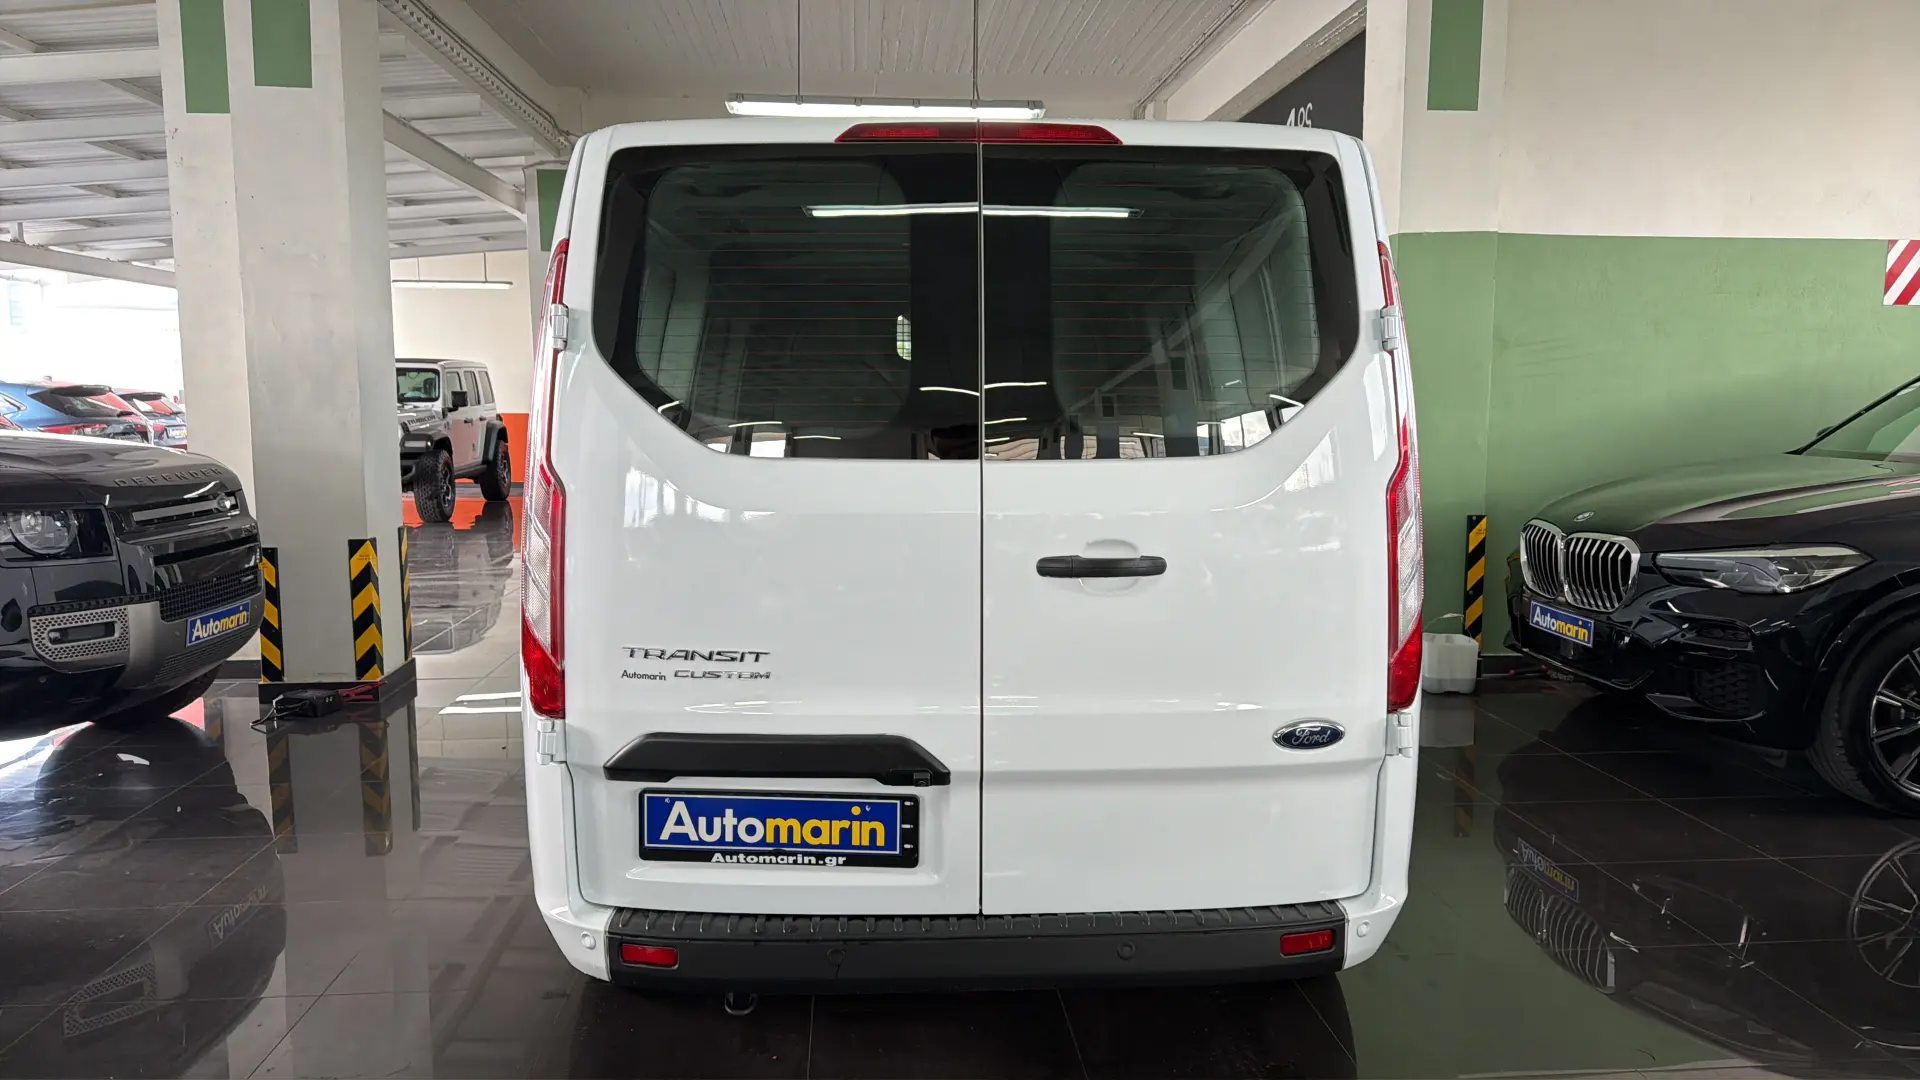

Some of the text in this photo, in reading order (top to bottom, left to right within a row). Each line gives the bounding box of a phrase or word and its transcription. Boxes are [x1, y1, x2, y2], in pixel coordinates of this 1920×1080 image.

[113, 467, 223, 488] DEFENDER
[192, 605, 248, 642] Automarin
[1532, 605, 1589, 642] Automarin
[622, 646, 771, 663] TRANSIT
[620, 669, 667, 682] Automarin
[674, 669, 771, 680] CUSTOM
[1291, 725, 1332, 746] Ford
[659, 800, 885, 847] Automarin
[710, 852, 847, 867] Automarin.gr
